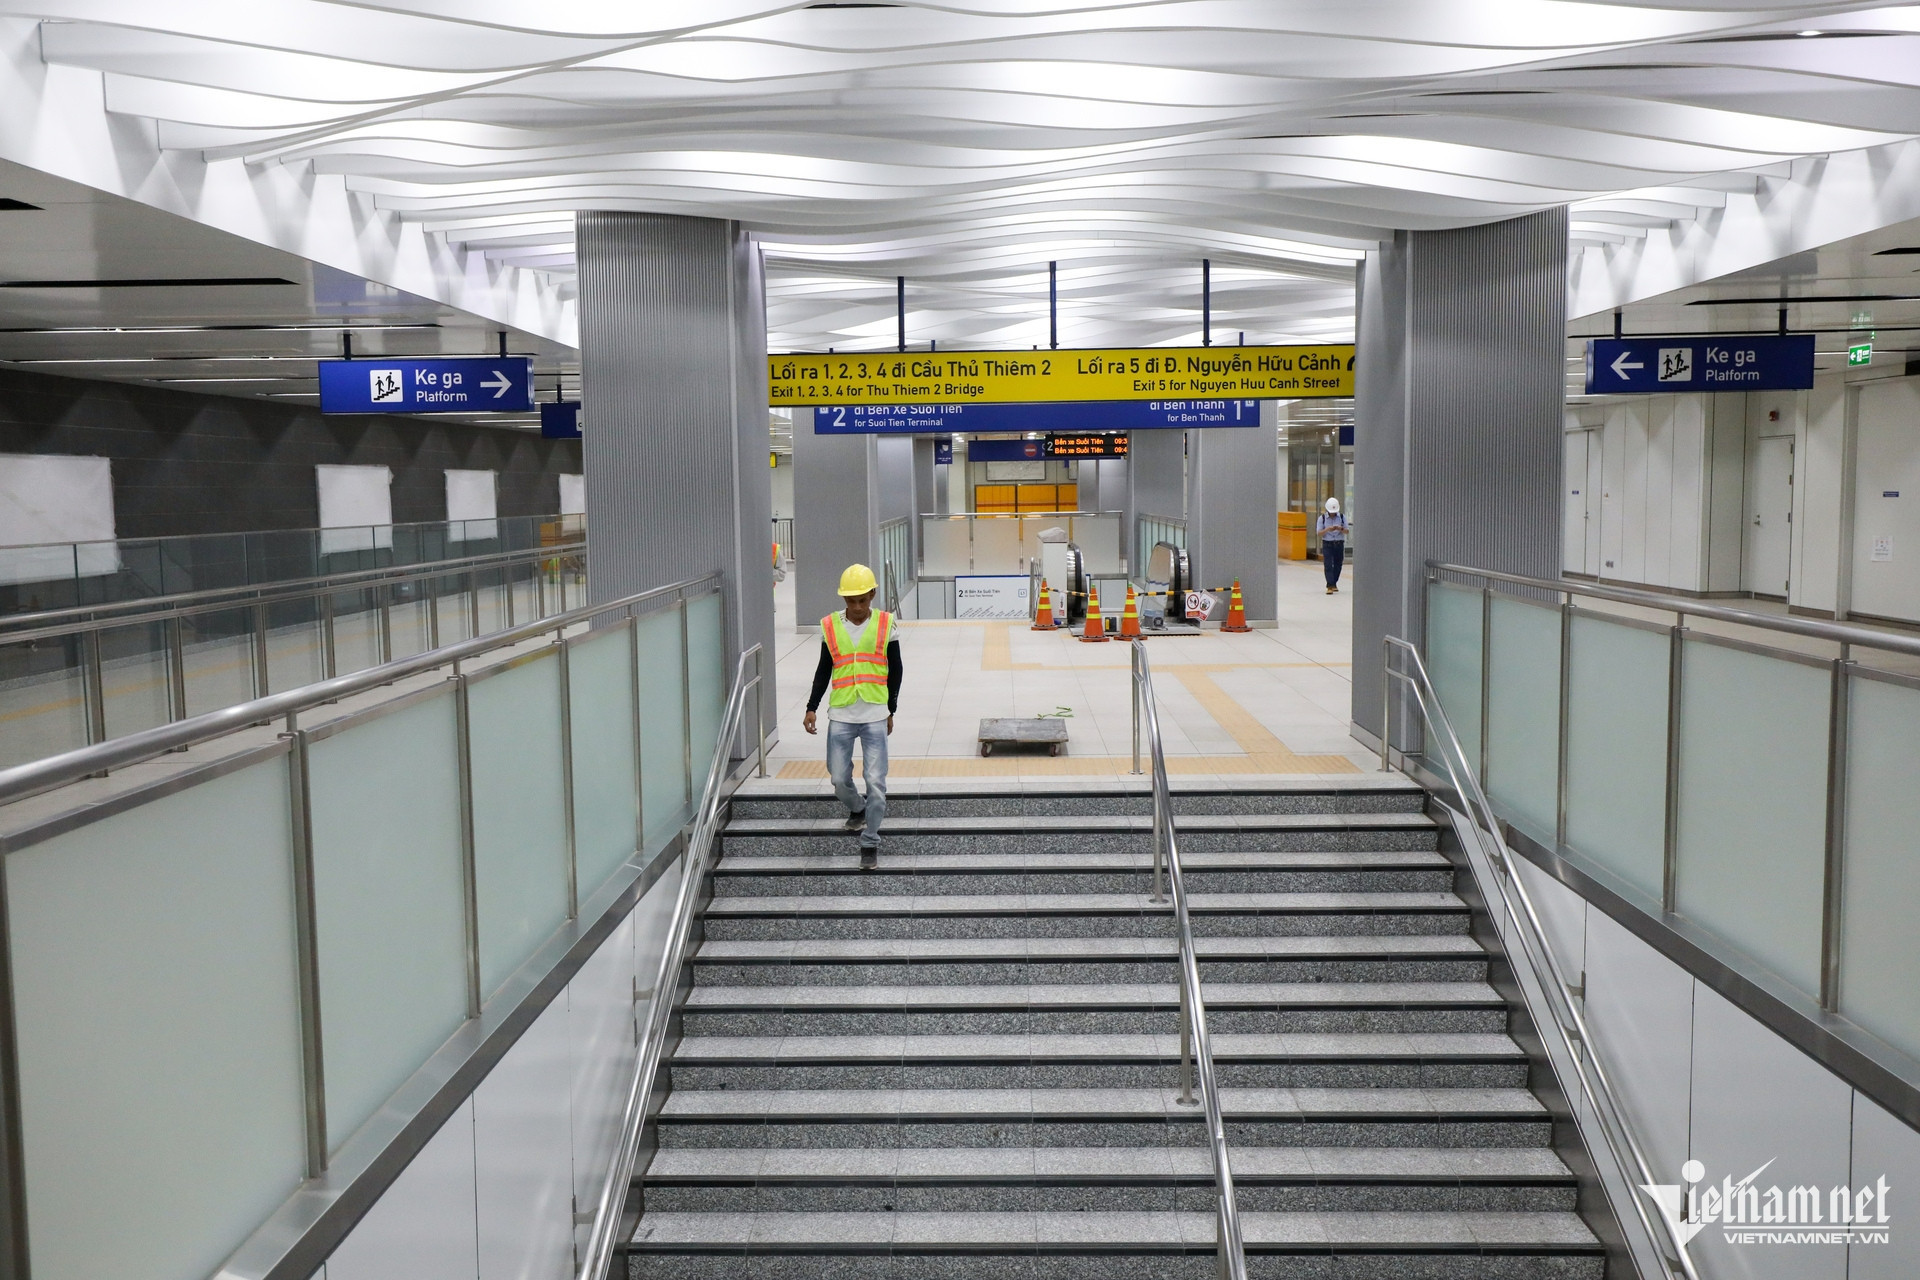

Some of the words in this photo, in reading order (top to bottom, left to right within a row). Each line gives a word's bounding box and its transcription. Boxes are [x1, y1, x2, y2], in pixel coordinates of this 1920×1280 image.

[1078, 356, 1102, 374] Lối
[1108, 362, 1125, 374] ra
[1130, 358, 1139, 373] 5
[1145, 357, 1158, 373] đi
[1165, 357, 1181, 373] Đ.
[1187, 353, 1252, 376] Nguyễn
[1258, 355, 1292, 371] Hữu
[1299, 353, 1340, 370] Cảnh
[1706, 347, 1729, 363] Ke
[1735, 350, 1756, 367] ga
[771, 362, 796, 380] Lối
[801, 368, 818, 379] ra
[823, 363, 834, 380] 1,
[839, 363, 853, 380] 2,
[857, 363, 872, 379] 3,
[877, 363, 886, 378] 4
[892, 362, 906, 378] đi
[911, 360, 942, 377] Cầu
[947, 359, 978, 376] Thủ
[984, 360, 1035, 376] Thiêm
[1042, 360, 1051, 375] 2
[1706, 369, 1760, 381] Platform
[415, 369, 437, 385] Ke
[442, 372, 462, 388] ga
[1134, 380, 1155, 391] Exit
[1159, 380, 1165, 390] 5
[1169, 380, 1186, 390] for
[1190, 379, 1236, 392] Nguyen
[1241, 378, 1264, 389] Huu
[1269, 377, 1299, 389] Canh
[1303, 377, 1340, 388] Street
[416, 391, 467, 402] Platform
[772, 386, 793, 397] Exit
[797, 386, 804, 397] 1,
[808, 385, 818, 397] 2,
[822, 385, 832, 397] 3,
[836, 385, 843, 396] 4
[846, 385, 863, 396] for
[867, 384, 888, 395] Thu
[892, 384, 930, 395] Thiem
[934, 384, 941, 395] 2
[945, 383, 984, 397] Bridge
[833, 406, 846, 427] 2
[1199, 413, 1225, 421] Thanh
[1234, 400, 1241, 420] 1
[854, 419, 866, 427] for
[888, 418, 905, 426] Tien
[907, 418, 943, 426] Terminal
[1047, 442, 1053, 451] 2
